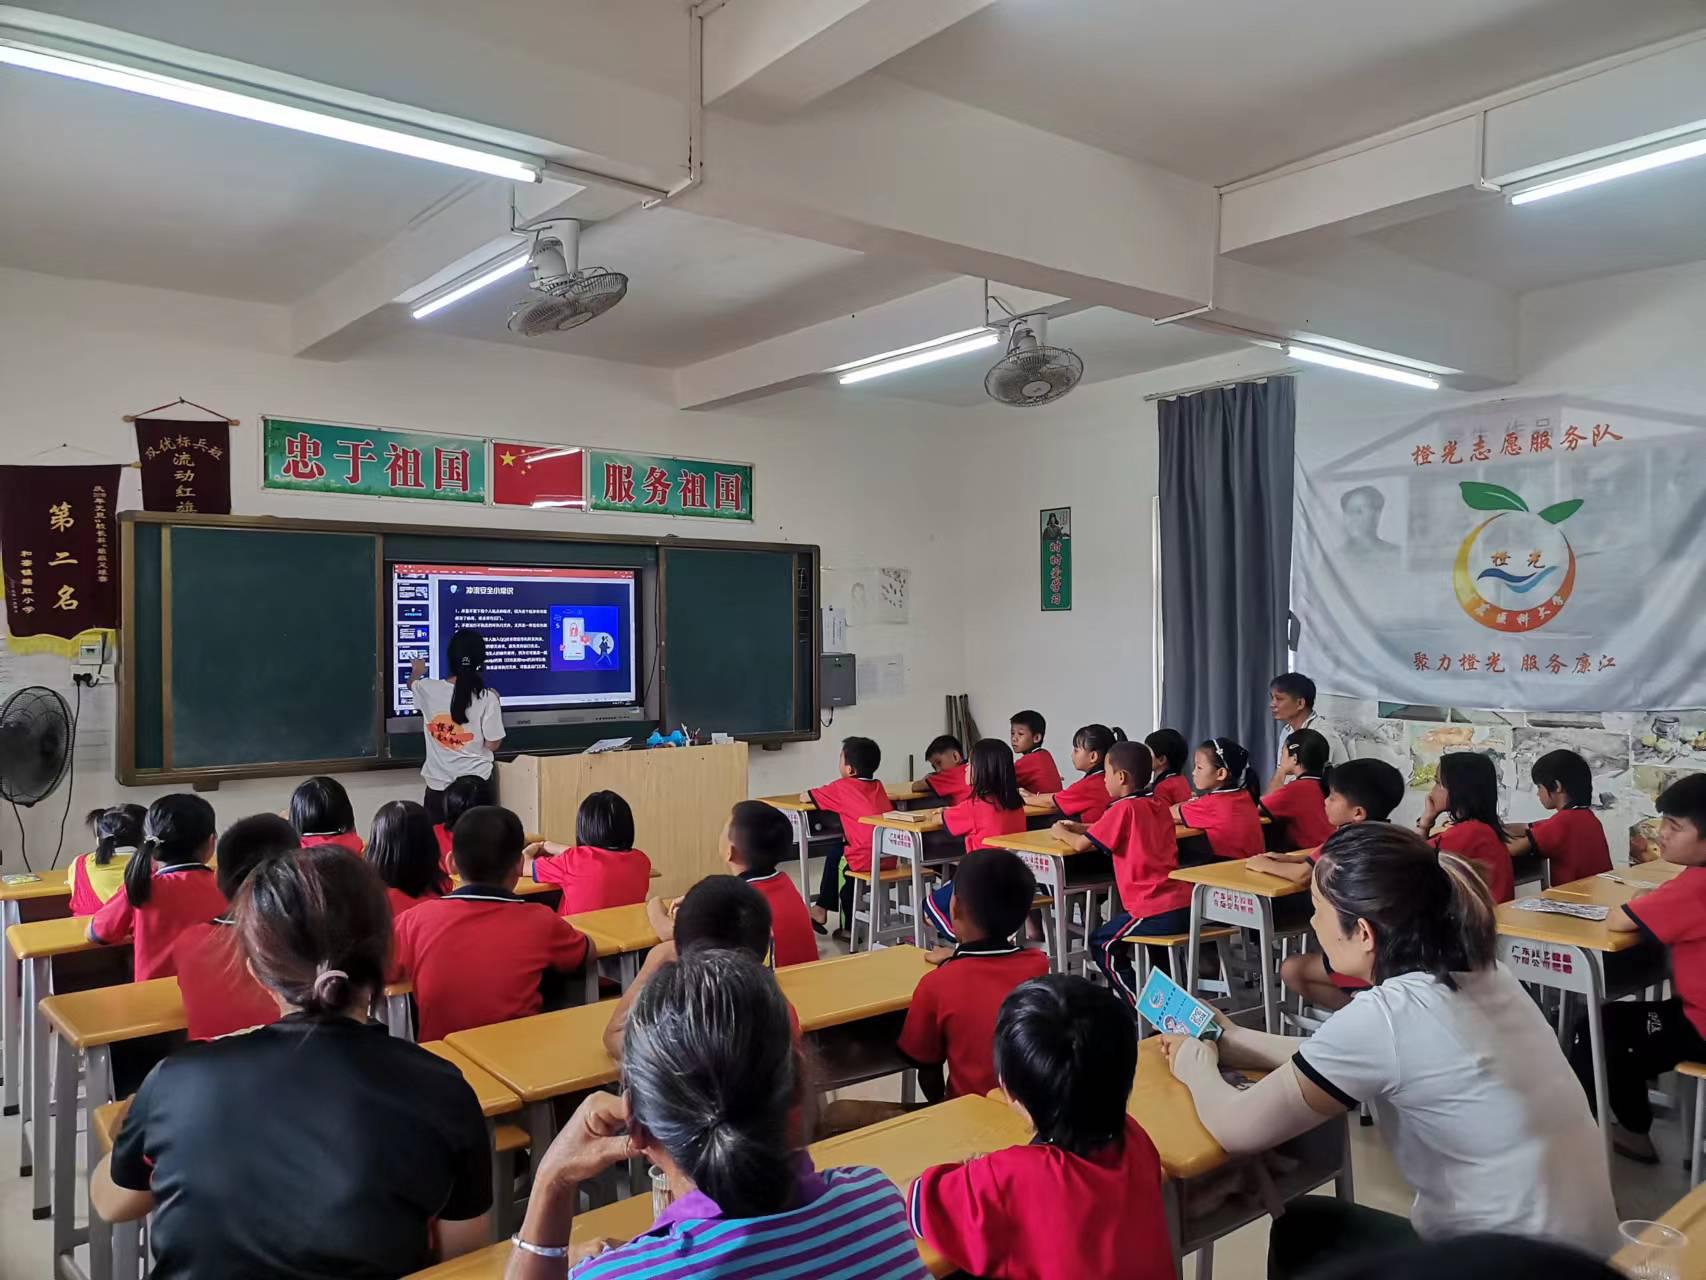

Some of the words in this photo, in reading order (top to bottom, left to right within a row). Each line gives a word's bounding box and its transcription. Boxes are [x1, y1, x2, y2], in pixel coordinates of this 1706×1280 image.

[282, 432, 471, 493] 忠于祖国
[1411, 423, 1624, 467] 橙光志愿服务队
[172, 452, 199, 513] 流动红旗
[602, 461, 744, 512] 服务祖国
[48, 501, 79, 611] 第二名
[1490, 549, 1546, 568] 橙光
[1413, 651, 1505, 672] 聚力橙光
[1520, 652, 1617, 674] 服务廉江
